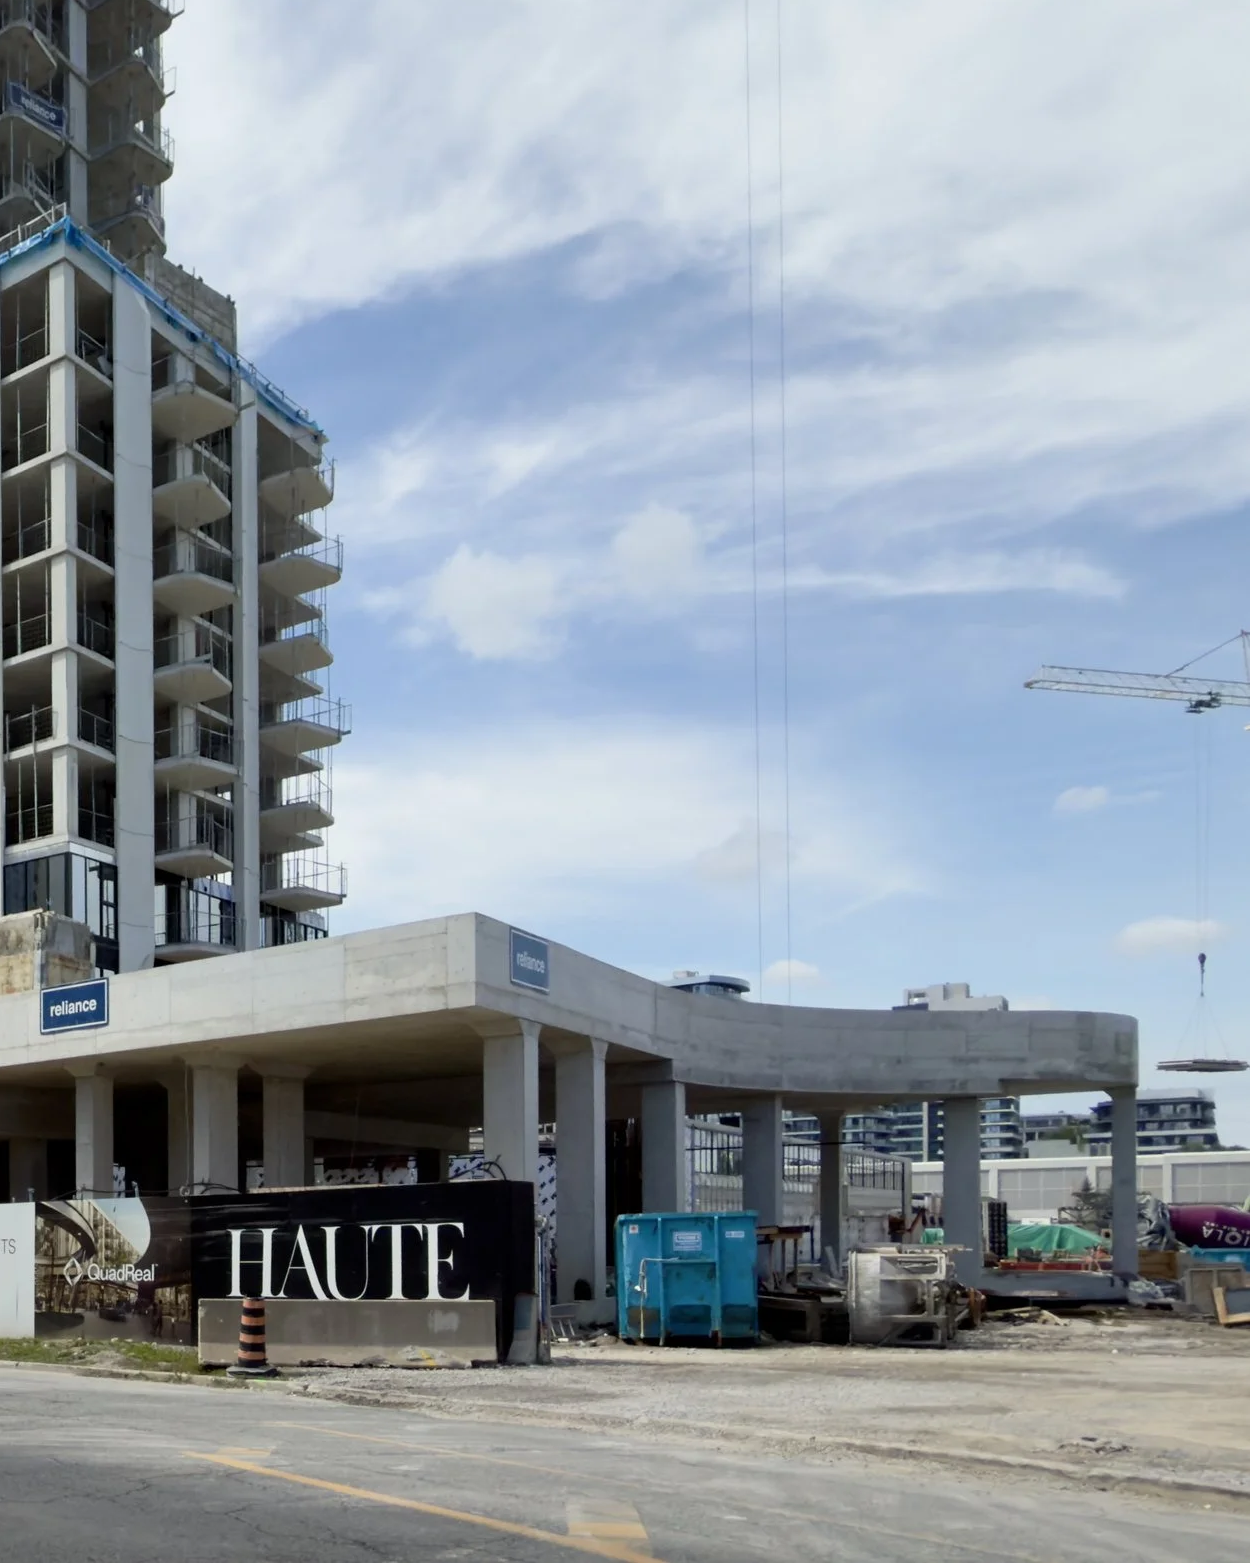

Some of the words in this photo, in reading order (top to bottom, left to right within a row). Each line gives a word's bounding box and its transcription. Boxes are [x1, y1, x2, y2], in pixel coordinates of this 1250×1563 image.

[21, 96, 56, 121] reliance
[516, 951, 545, 974] reliance
[50, 999, 97, 1017] reliance
[87, 1262, 155, 1282] QuadReal
[226, 1222, 470, 1301] HAUTE
